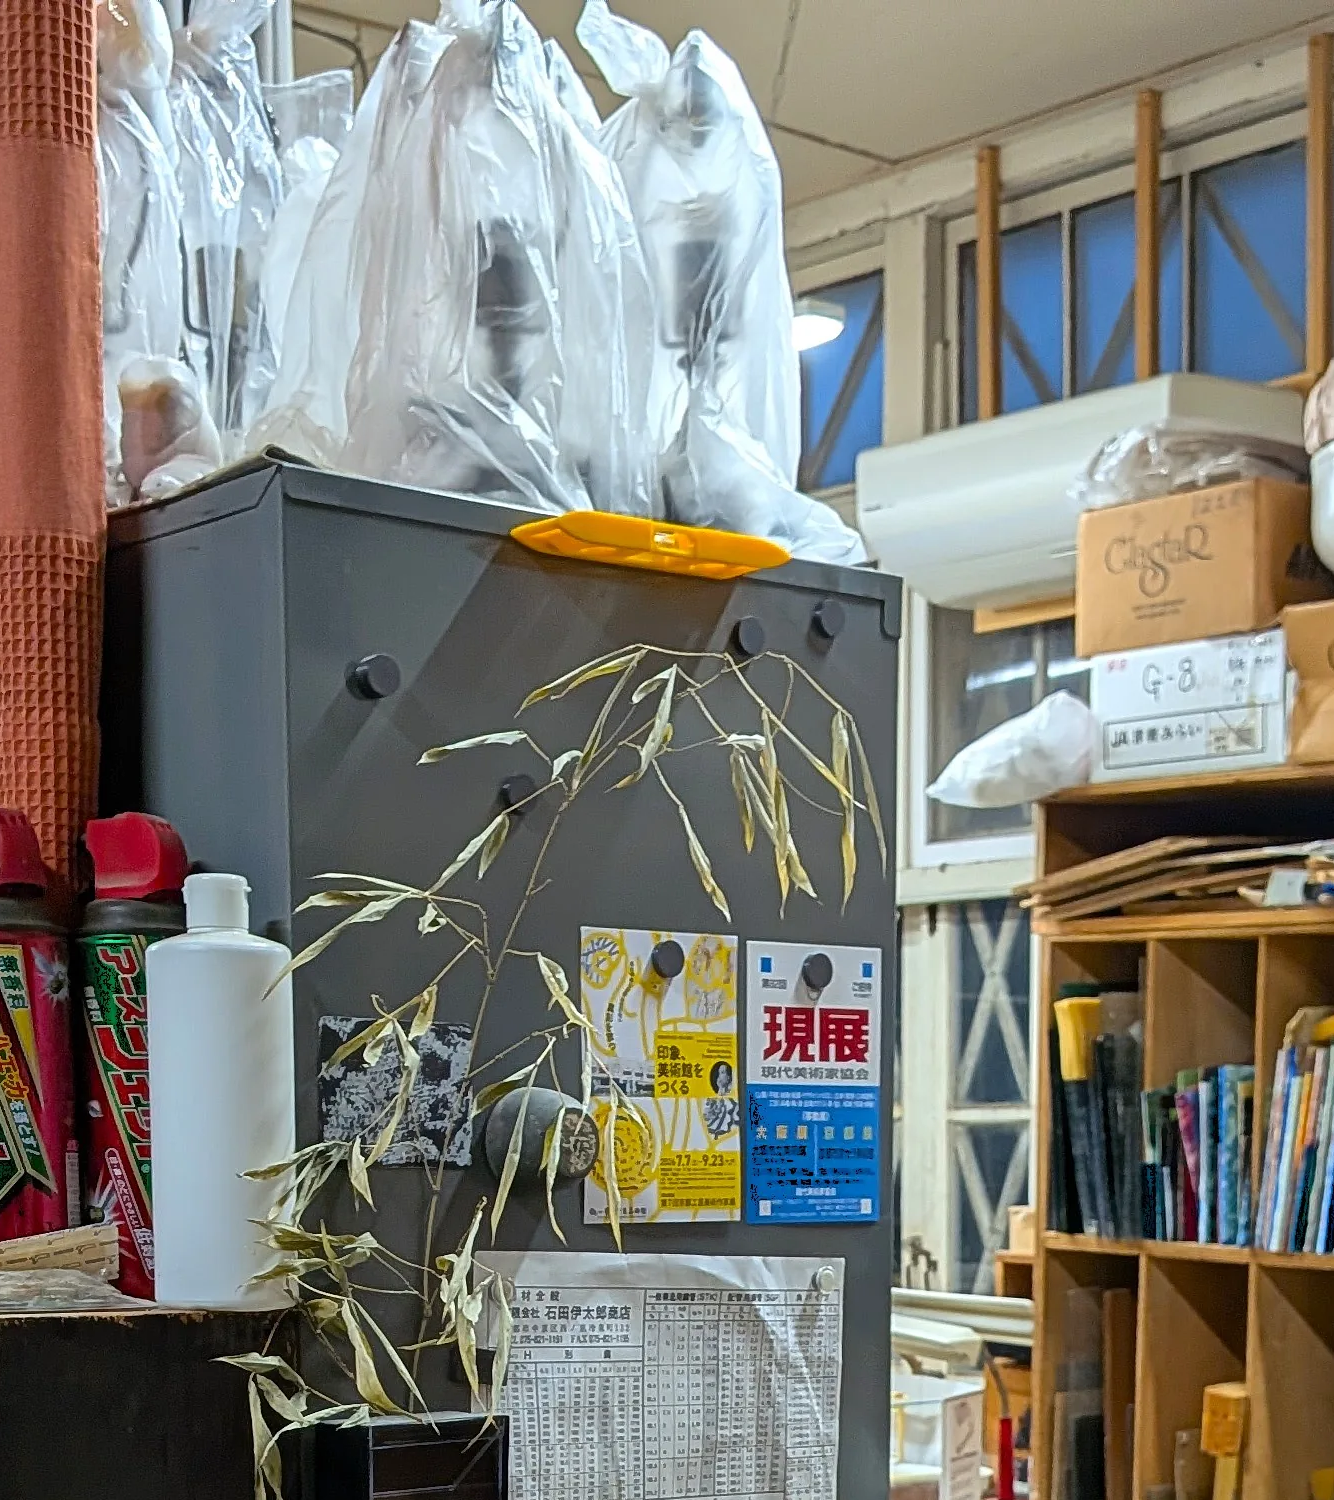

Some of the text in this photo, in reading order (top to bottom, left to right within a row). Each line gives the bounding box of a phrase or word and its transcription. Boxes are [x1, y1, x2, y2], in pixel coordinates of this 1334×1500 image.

[763, 1005, 869, 1063] 現展
[761, 1065, 870, 1081] 現代美術家協会
[657, 1079, 690, 1096] つくる
